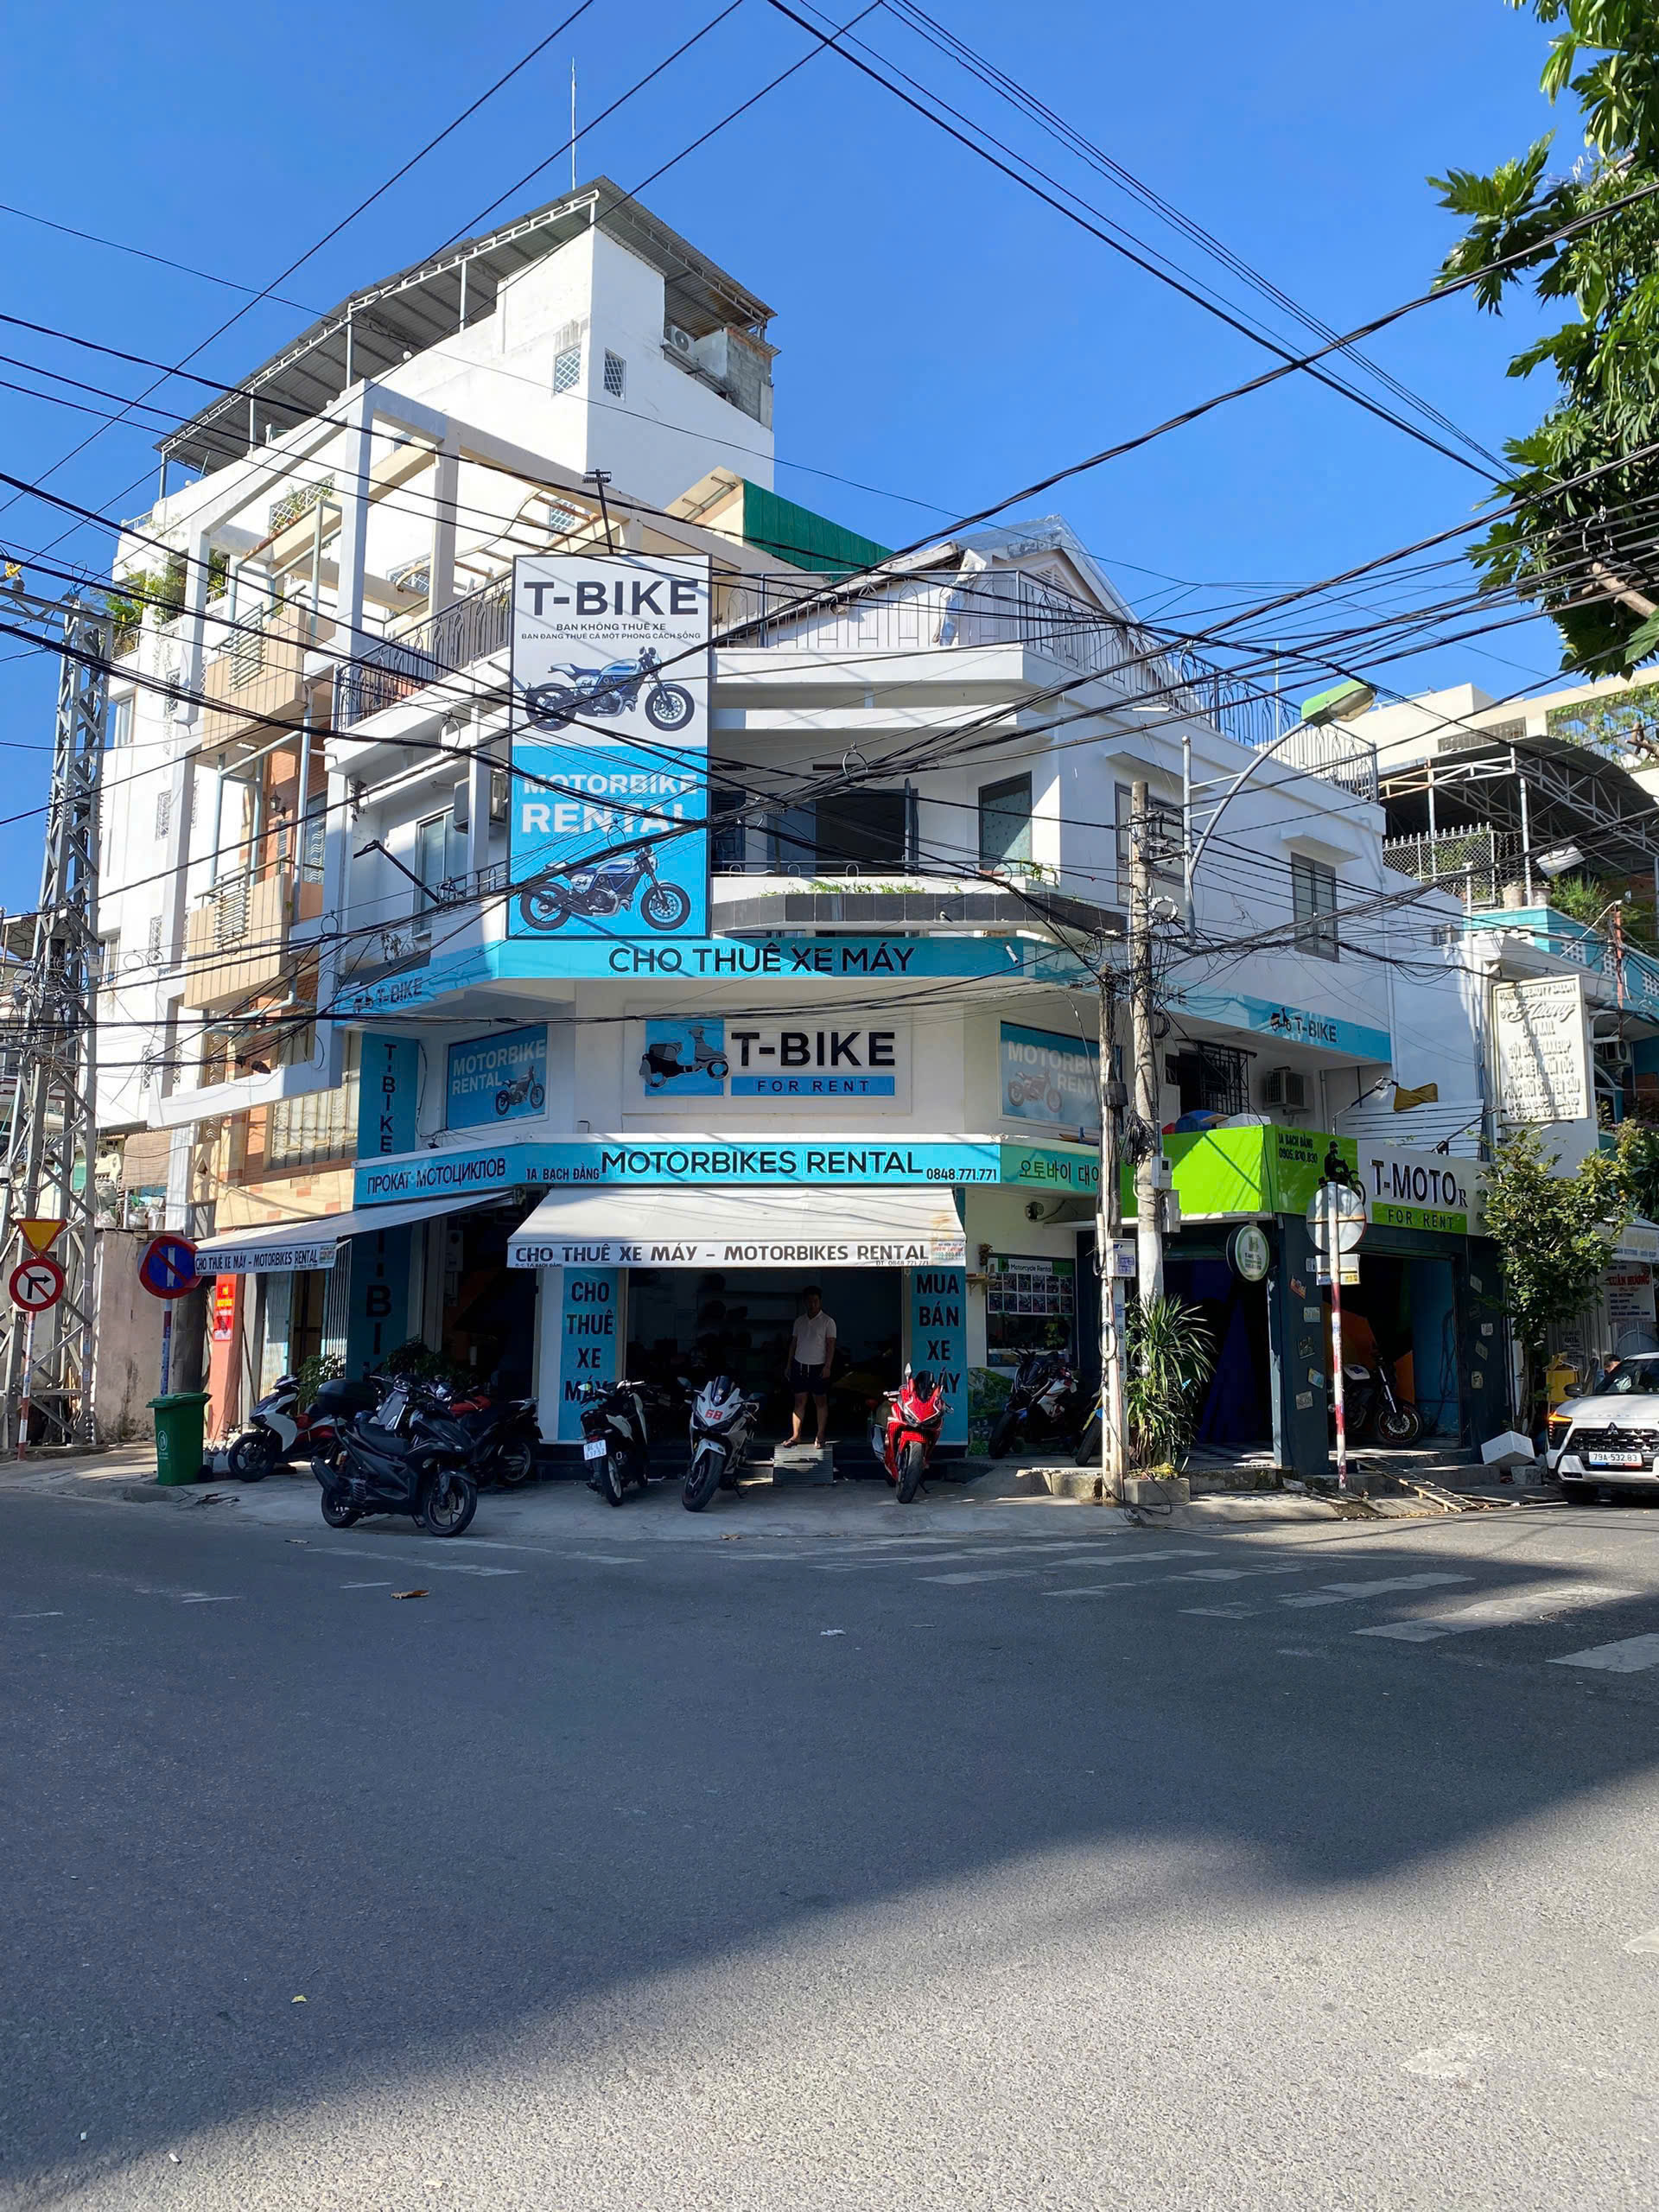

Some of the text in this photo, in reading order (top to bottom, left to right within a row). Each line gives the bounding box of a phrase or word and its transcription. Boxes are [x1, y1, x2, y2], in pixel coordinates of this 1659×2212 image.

[524, 581, 699, 616] T-BIKE
[524, 774, 698, 794] MOTORBIKE
[608, 942, 916, 973] CHO THUÊ XE MÁY
[1294, 1015, 1338, 1043] T-BIKE
[452, 1039, 546, 1077] MOTORBIKE
[731, 1032, 895, 1067] T-BIKE
[452, 1071, 503, 1096] RENTAL
[757, 1079, 869, 1092] FOR RENT
[601, 1150, 924, 1173] MOTORBIKES RENTAL
[1019, 1160, 1071, 1183] 오토바이
[367, 1171, 412, 1194] ПРОКАТ
[526, 1167, 537, 1180] 1A
[543, 1167, 569, 1181] BẠCH
[926, 1168, 997, 1181] 0848.771.771
[1388, 1209, 1453, 1230] FOR RENT
[195, 1257, 207, 1270] CHO
[225, 1255, 232, 1269] XE
[253, 1251, 292, 1268] MOTORBIKES
[294, 1249, 318, 1264] RENTAL
[515, 1246, 554, 1262] CHO
[563, 1243, 611, 1262] THUÊ
[619, 1246, 643, 1262] XE
[651, 1243, 698, 1262] MÁY
[724, 1245, 848, 1261] MOTORBIKES
[857, 1245, 929, 1260] RENTAL
[1010, 1263, 1036, 1272] Motorcycle
[571, 1281, 610, 1302] CHO
[916, 1273, 960, 1294] MUA
[566, 1309, 614, 1335] THUÊ
[918, 1300, 959, 1327] BÁN
[576, 1347, 601, 1369] XE
[926, 1340, 951, 1361] XE
